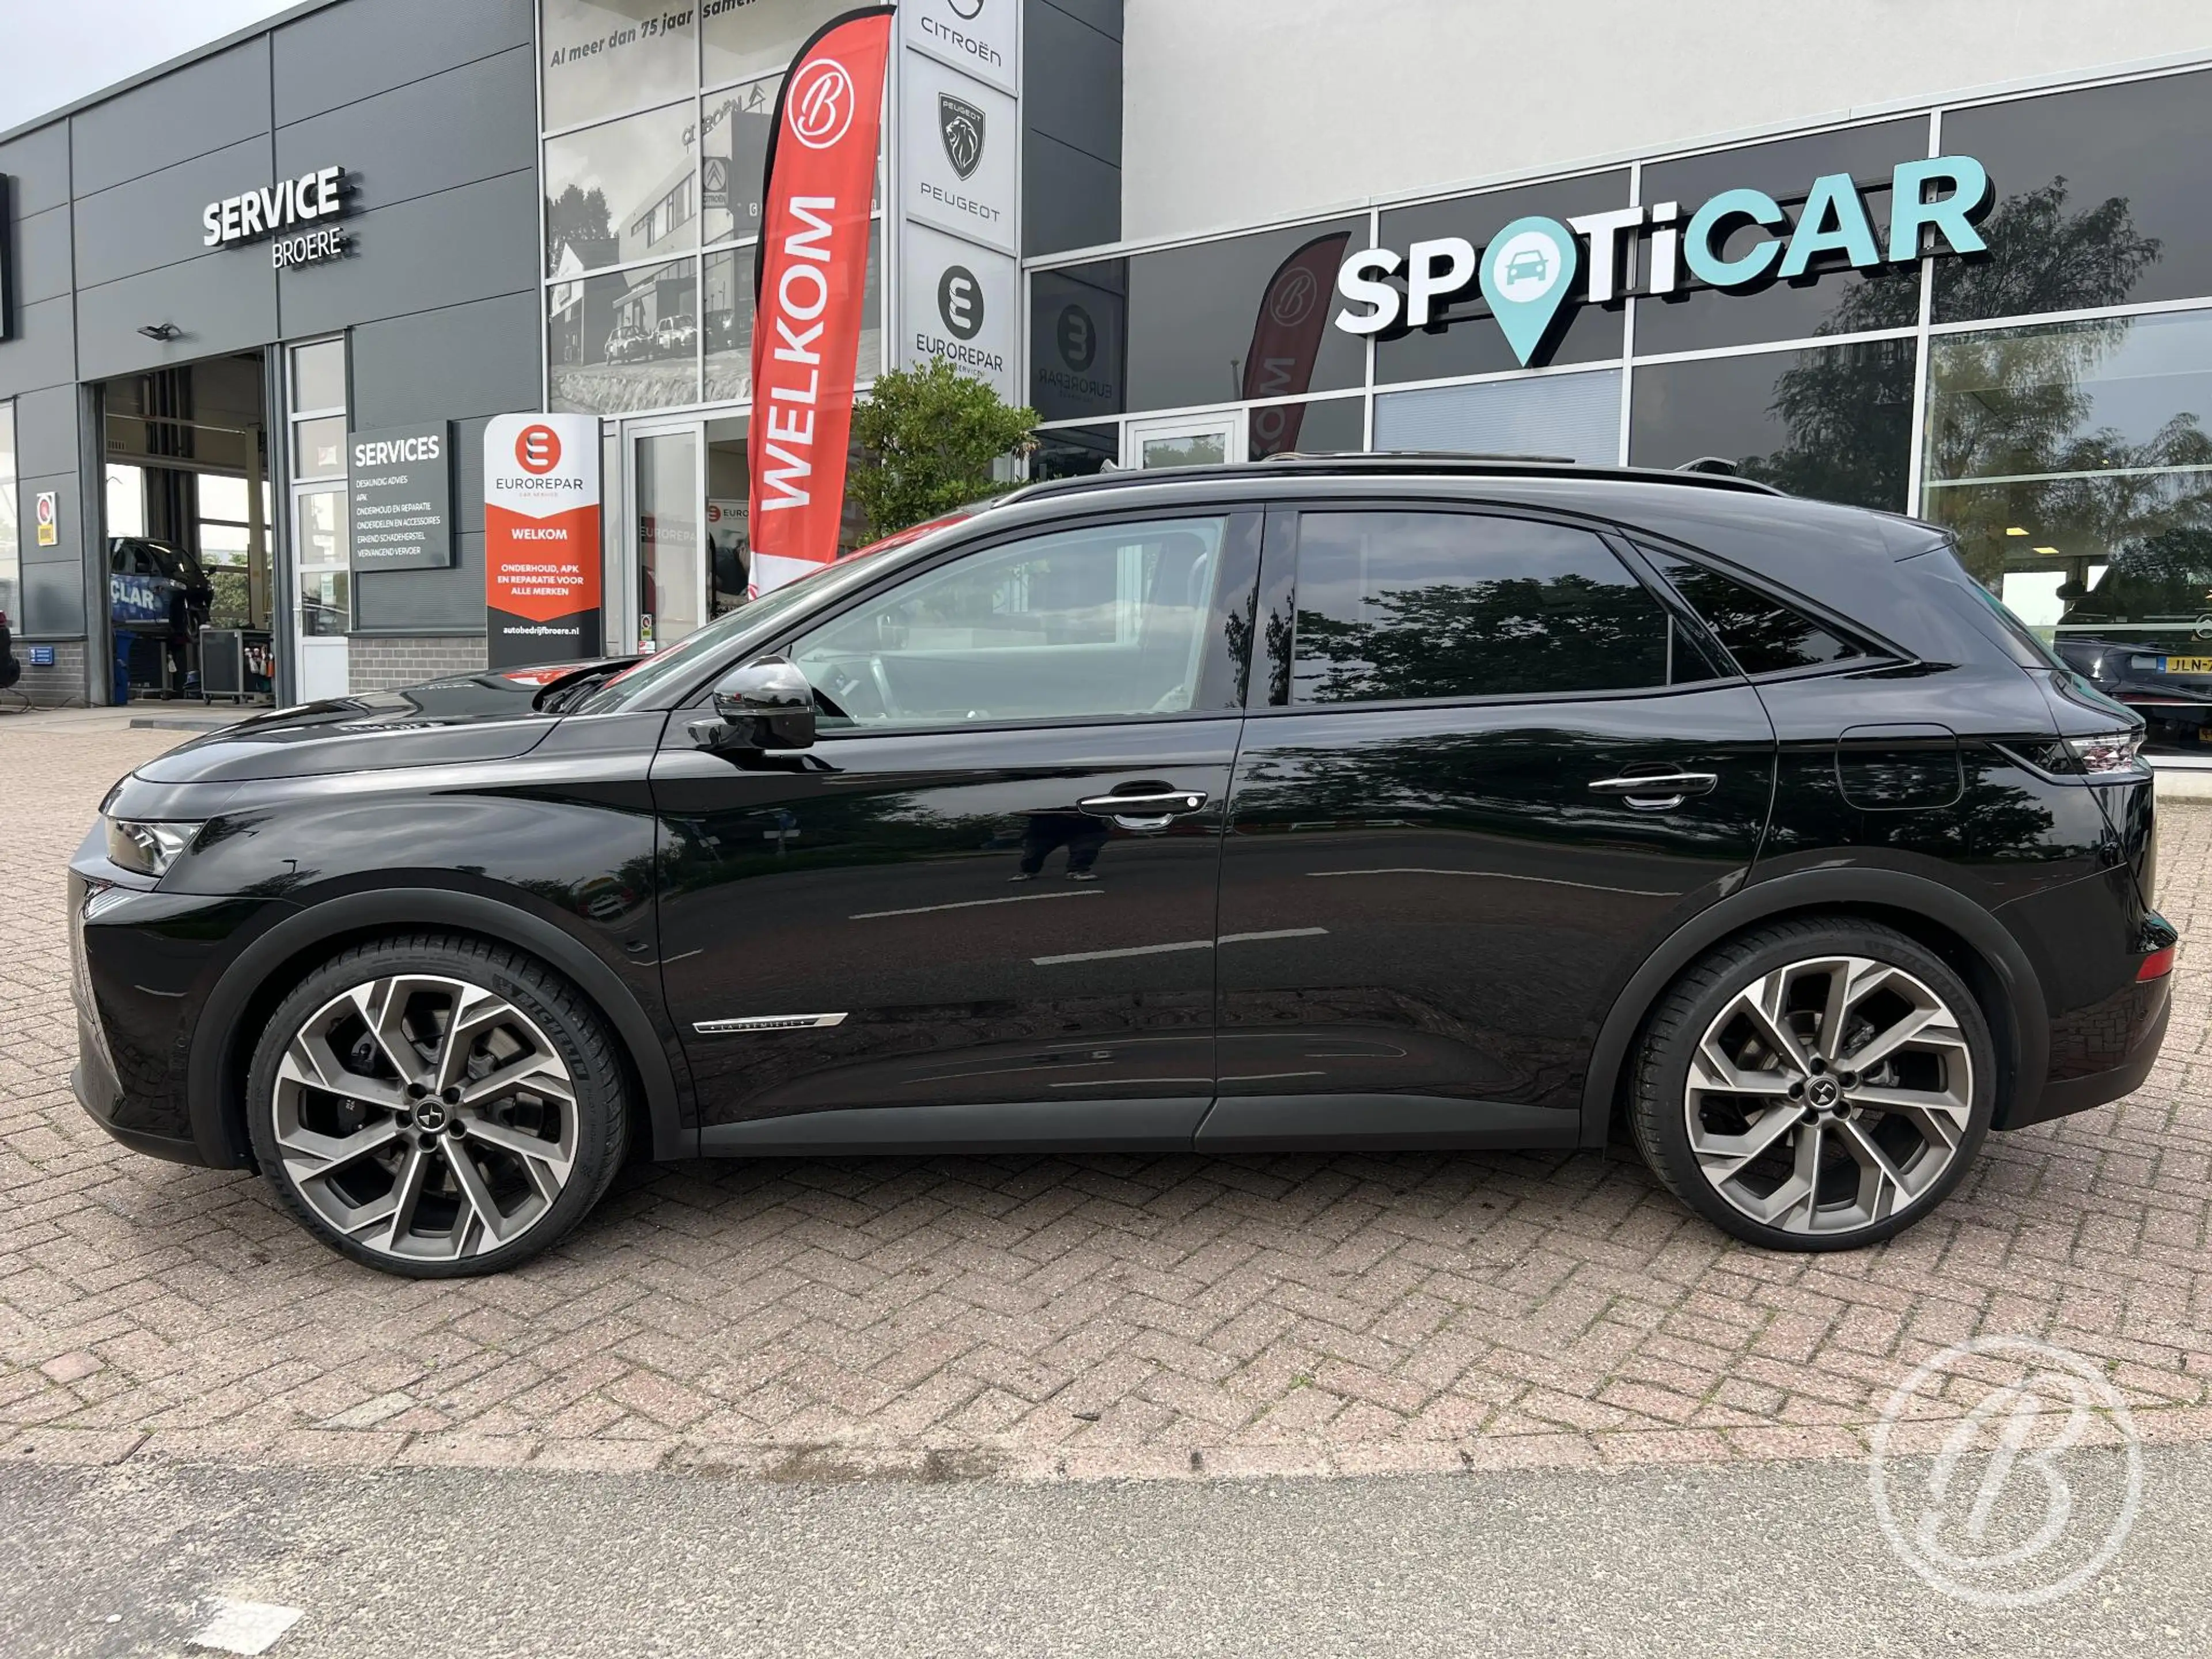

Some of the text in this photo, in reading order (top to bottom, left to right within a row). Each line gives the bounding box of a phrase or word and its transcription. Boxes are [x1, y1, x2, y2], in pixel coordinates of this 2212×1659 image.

[551, 47, 565, 67] Al
[569, 38, 605, 62] meer
[608, 29, 636, 48] dan
[641, 18, 658, 38] 75
[660, 10, 694, 36] jaar
[942, 101, 982, 122] PEUGEOT
[203, 166, 340, 247] SERVICE
[921, 182, 1000, 222] PEUGEOT
[272, 227, 341, 268] BROERE
[761, 196, 836, 512] WELKOM
[916, 333, 1003, 372] EUROREPAR
[355, 435, 440, 467] SERVICES
[357, 475, 408, 488] DESKUNDIG ADVIES
[497, 479, 583, 490] EUROREPAR
[357, 502, 431, 516] ONDERHOUD EN REPARATIE
[724, 509, 749, 518] EURO
[357, 516, 441, 529] ONDERDELEN EN ACCESSOIRES
[357, 531, 426, 543] ERKEND SCHADEHERSTEL
[512, 528, 568, 540] WELKOM
[640, 525, 698, 541] EUROREPA
[357, 546, 421, 557] VERVANGEND VERVOER
[501, 564, 579, 574] ONDERHOUD, APK
[497, 575, 584, 585] EN REPARATIE VOOR
[533, 588, 569, 596] MERKEN
[503, 626, 579, 635] autobedrijfbroere.nl
[517, 990, 589, 1076] MICHELIN
